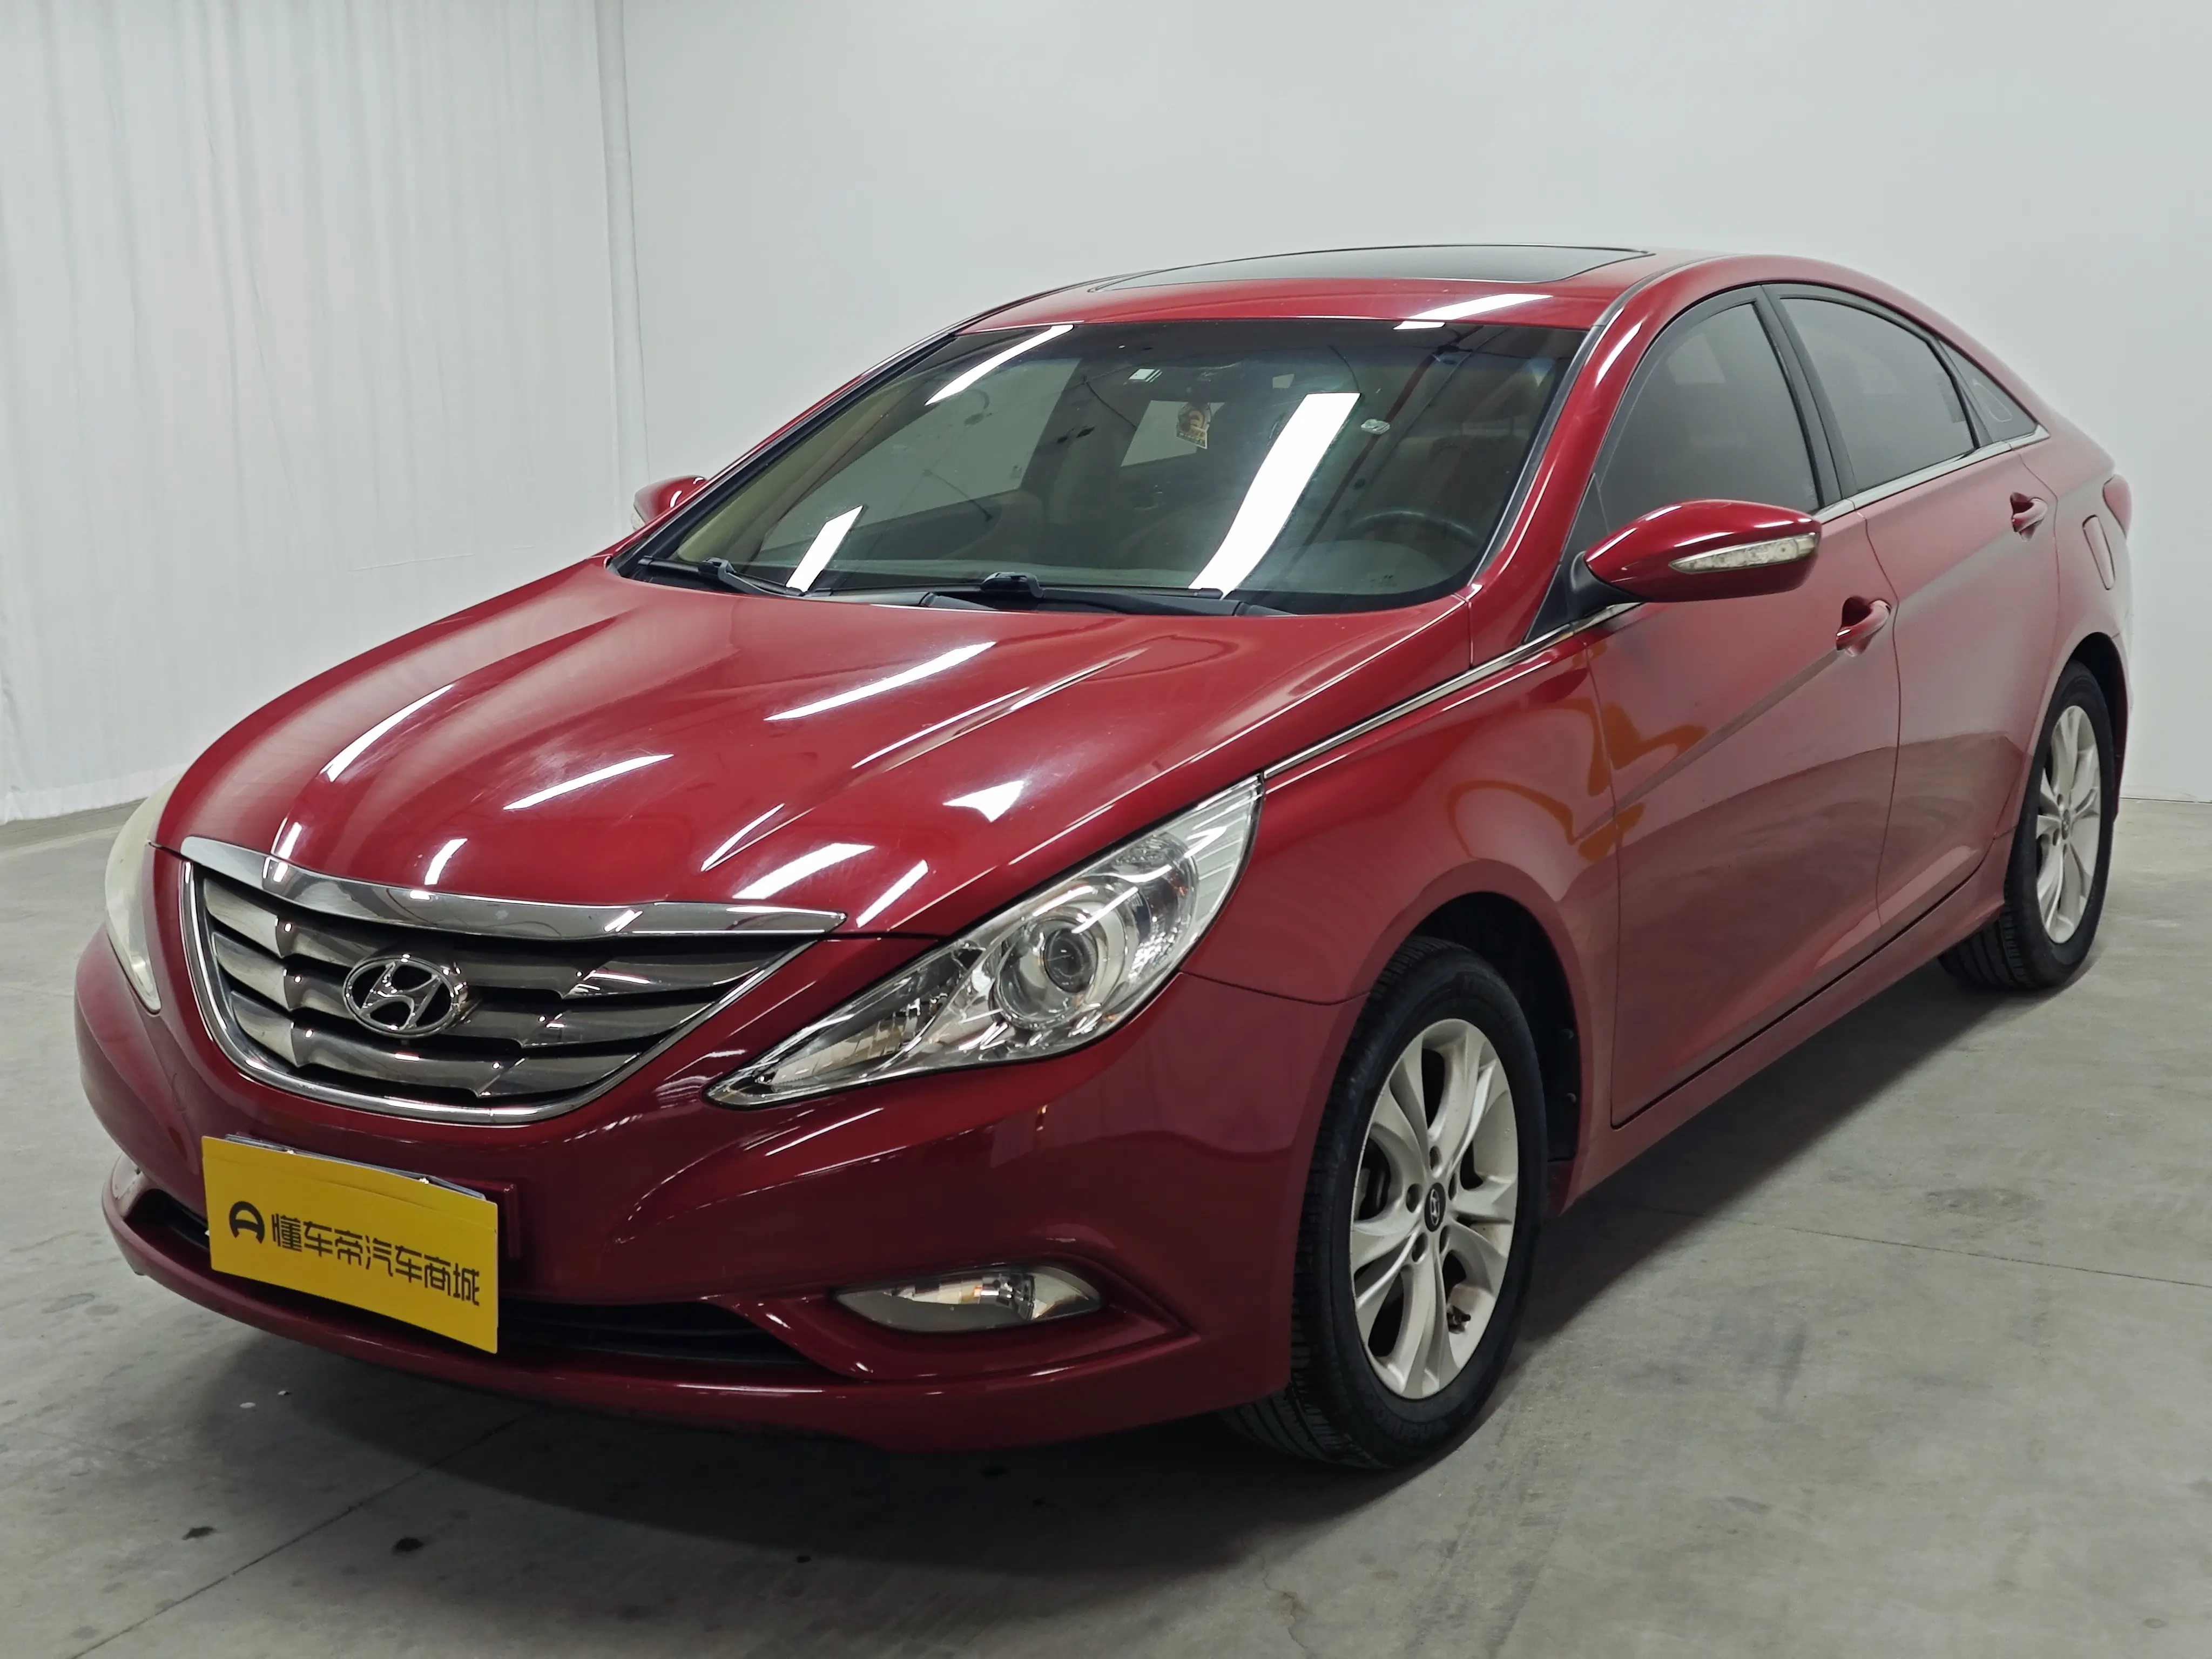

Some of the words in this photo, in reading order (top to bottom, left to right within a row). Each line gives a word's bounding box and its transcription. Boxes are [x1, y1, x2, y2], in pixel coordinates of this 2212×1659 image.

[272, 1213, 480, 1306] 懂车帝汽车商城
